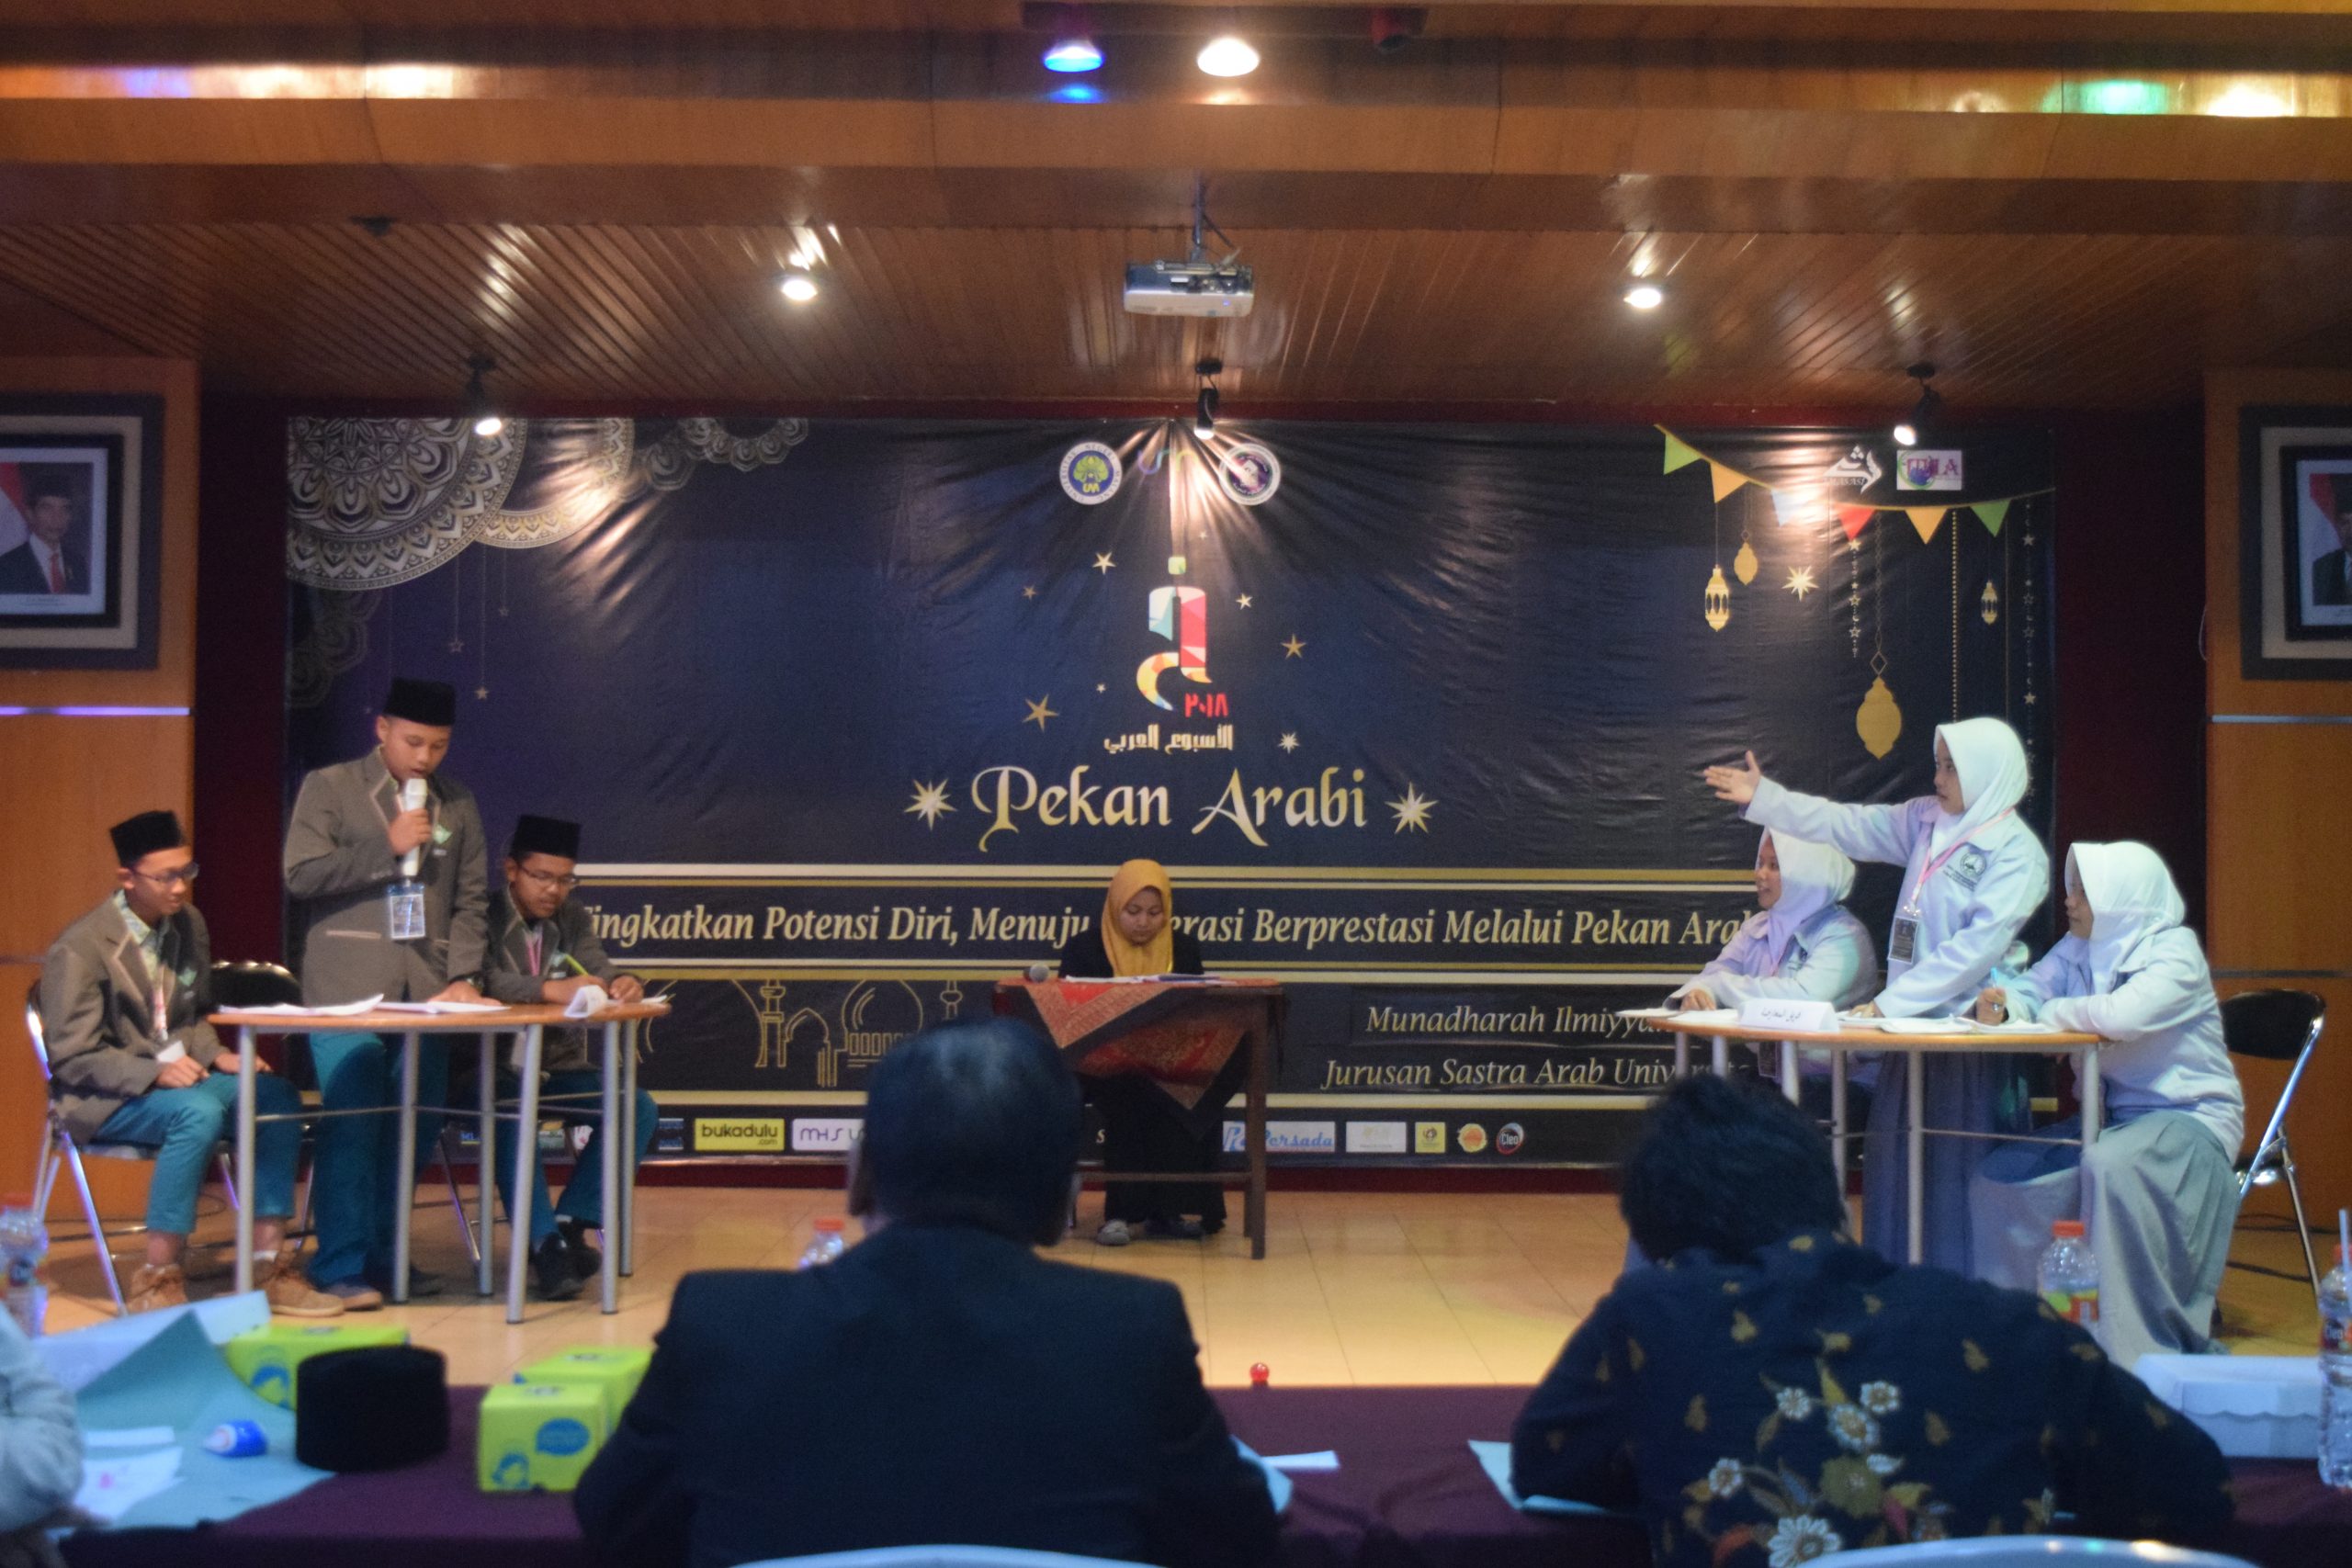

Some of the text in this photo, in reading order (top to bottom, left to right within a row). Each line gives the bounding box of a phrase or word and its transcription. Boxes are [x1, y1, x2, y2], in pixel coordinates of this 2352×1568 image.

[1103, 723, 1159, 755] العربي
[971, 765, 1368, 852] Pekan Arabi
[583, 904, 753, 948] ingkatkan
[763, 906, 880, 941] Potensi
[888, 907, 958, 946] Diri,
[1252, 909, 1435, 950] Berprestasi
[1442, 910, 1562, 944] Melalui
[1570, 909, 1671, 945] Pekan
[1365, 1005, 1545, 1032] Munadharah
[1320, 1060, 1431, 1090] Jurusan
[1440, 1057, 1526, 1085] Sastra
[1533, 1058, 1604, 1085] Arab
[701, 1123, 778, 1138] bukadulu
[1499, 1132, 1520, 1146] Cleo
